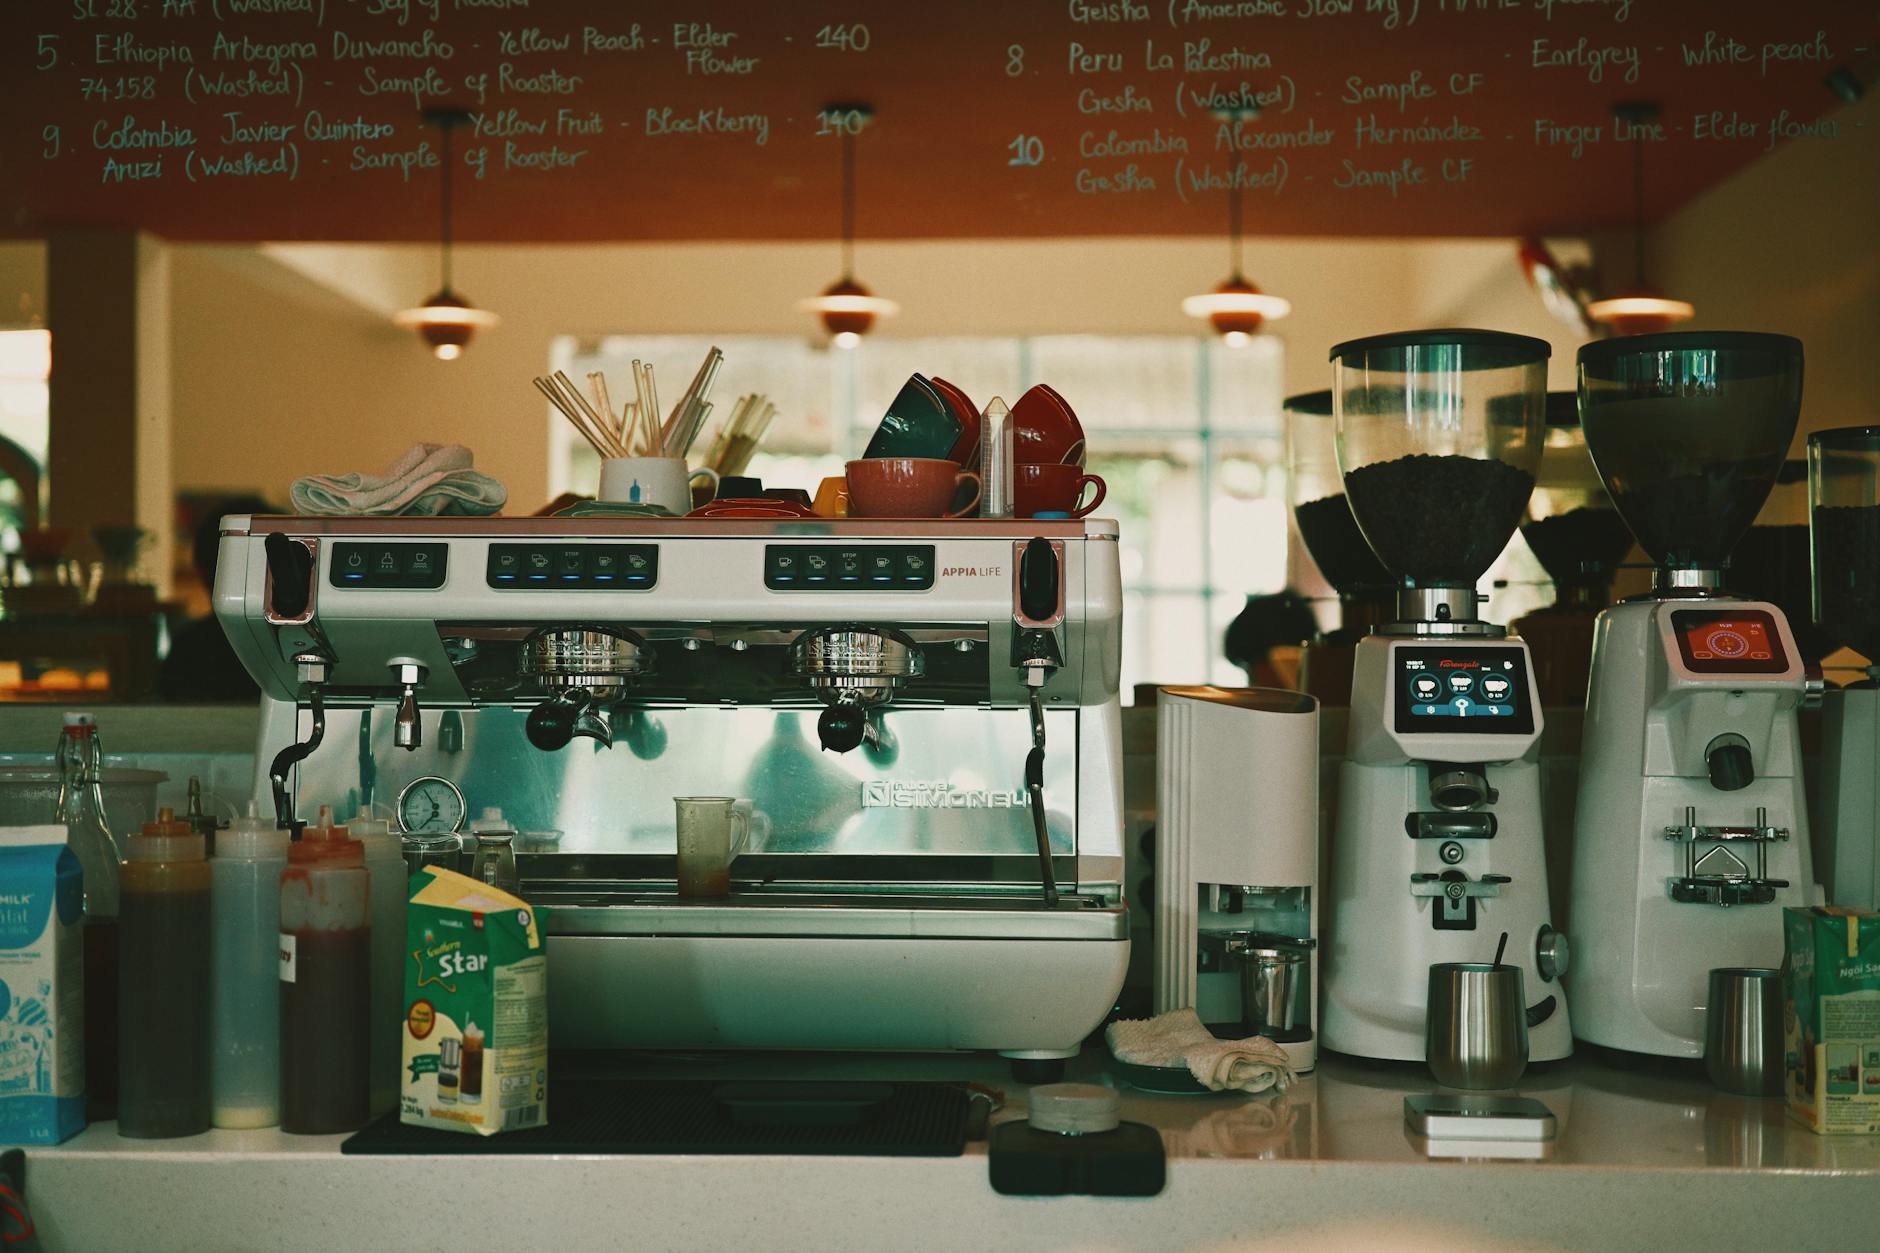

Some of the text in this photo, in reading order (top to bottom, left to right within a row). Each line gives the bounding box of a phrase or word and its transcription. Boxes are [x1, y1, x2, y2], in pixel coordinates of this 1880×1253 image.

[1069, 0, 1149, 24] Geisha
[95, 32, 193, 72] Ethiopia
[213, 31, 318, 75] Arbegona
[334, 29, 454, 60] Duwancho
[498, 28, 570, 55] Yellow
[583, 23, 644, 55] Peach
[673, 23, 738, 49] Elder
[815, 24, 870, 51] 140
[686, 49, 761, 75] Flower
[1069, 42, 1122, 75] Peru
[1146, 39, 1174, 72] La
[1184, 37, 1272, 73] Palestina
[1532, 37, 1640, 84] Earlgrey
[80, 76, 156, 101] 74158
[185, 62, 303, 107] (Washed)
[359, 66, 451, 110] Sample
[499, 62, 583, 94] Roaster
[1078, 70, 1487, 118] Gesha (Washed) Sample CF
[93, 115, 198, 149] Colombia
[220, 112, 296, 144] Javier
[303, 110, 394, 141] Quintero
[468, 108, 547, 138] Yellow
[558, 108, 603, 136] Fruit
[815, 110, 865, 137] 140
[1080, 129, 1189, 159] Colombia
[1215, 117, 1335, 152] Alexander
[1353, 112, 1486, 150] Hernández
[1535, 119, 1602, 160] Finger
[1615, 116, 1668, 141] Lime
[1693, 111, 1760, 141] Elder
[102, 154, 162, 184] Aruzi
[185, 142, 298, 182] (Washed)
[350, 142, 441, 182] Sample
[504, 140, 590, 172] Roaster
[1076, 164, 1156, 193] Gesha
[1334, 158, 1428, 198] Sample
[1442, 158, 1474, 182] CF
[942, 567, 1000, 577] APPIA LIFE
[894, 781, 951, 791] nuova
[439, 950, 488, 978] Star
